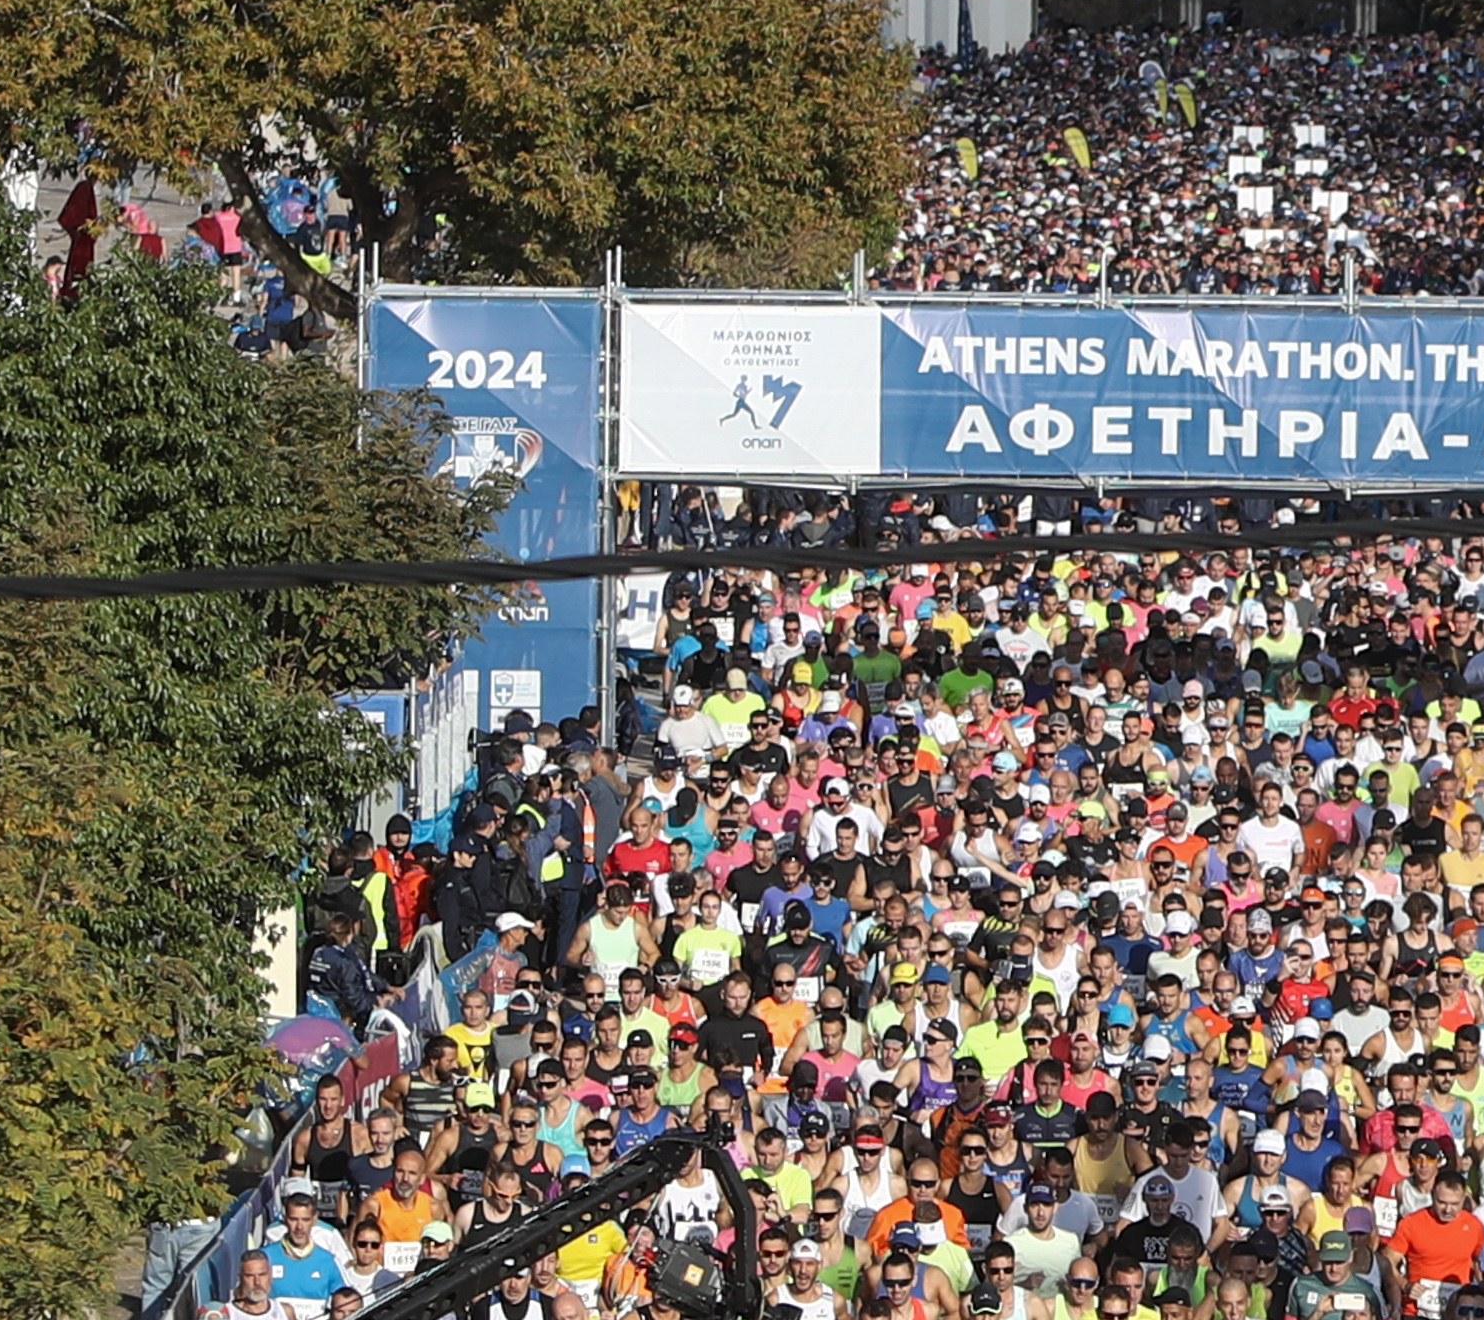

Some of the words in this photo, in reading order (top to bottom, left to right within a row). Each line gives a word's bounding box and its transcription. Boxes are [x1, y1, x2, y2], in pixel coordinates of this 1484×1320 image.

[713, 330, 811, 342] ΜΑΡΑΘΩΝΙΟΣ
[731, 344, 793, 355] ΑΘΗΝΑΣ
[734, 358, 800, 367] ΑΥΘΕΝΤΙΚΟΣ
[918, 337, 1106, 374] ATHENS
[1127, 338, 1414, 383] MARATHON.
[427, 351, 547, 388] 2024
[453, 416, 518, 434] ΣΕΓΑΣ
